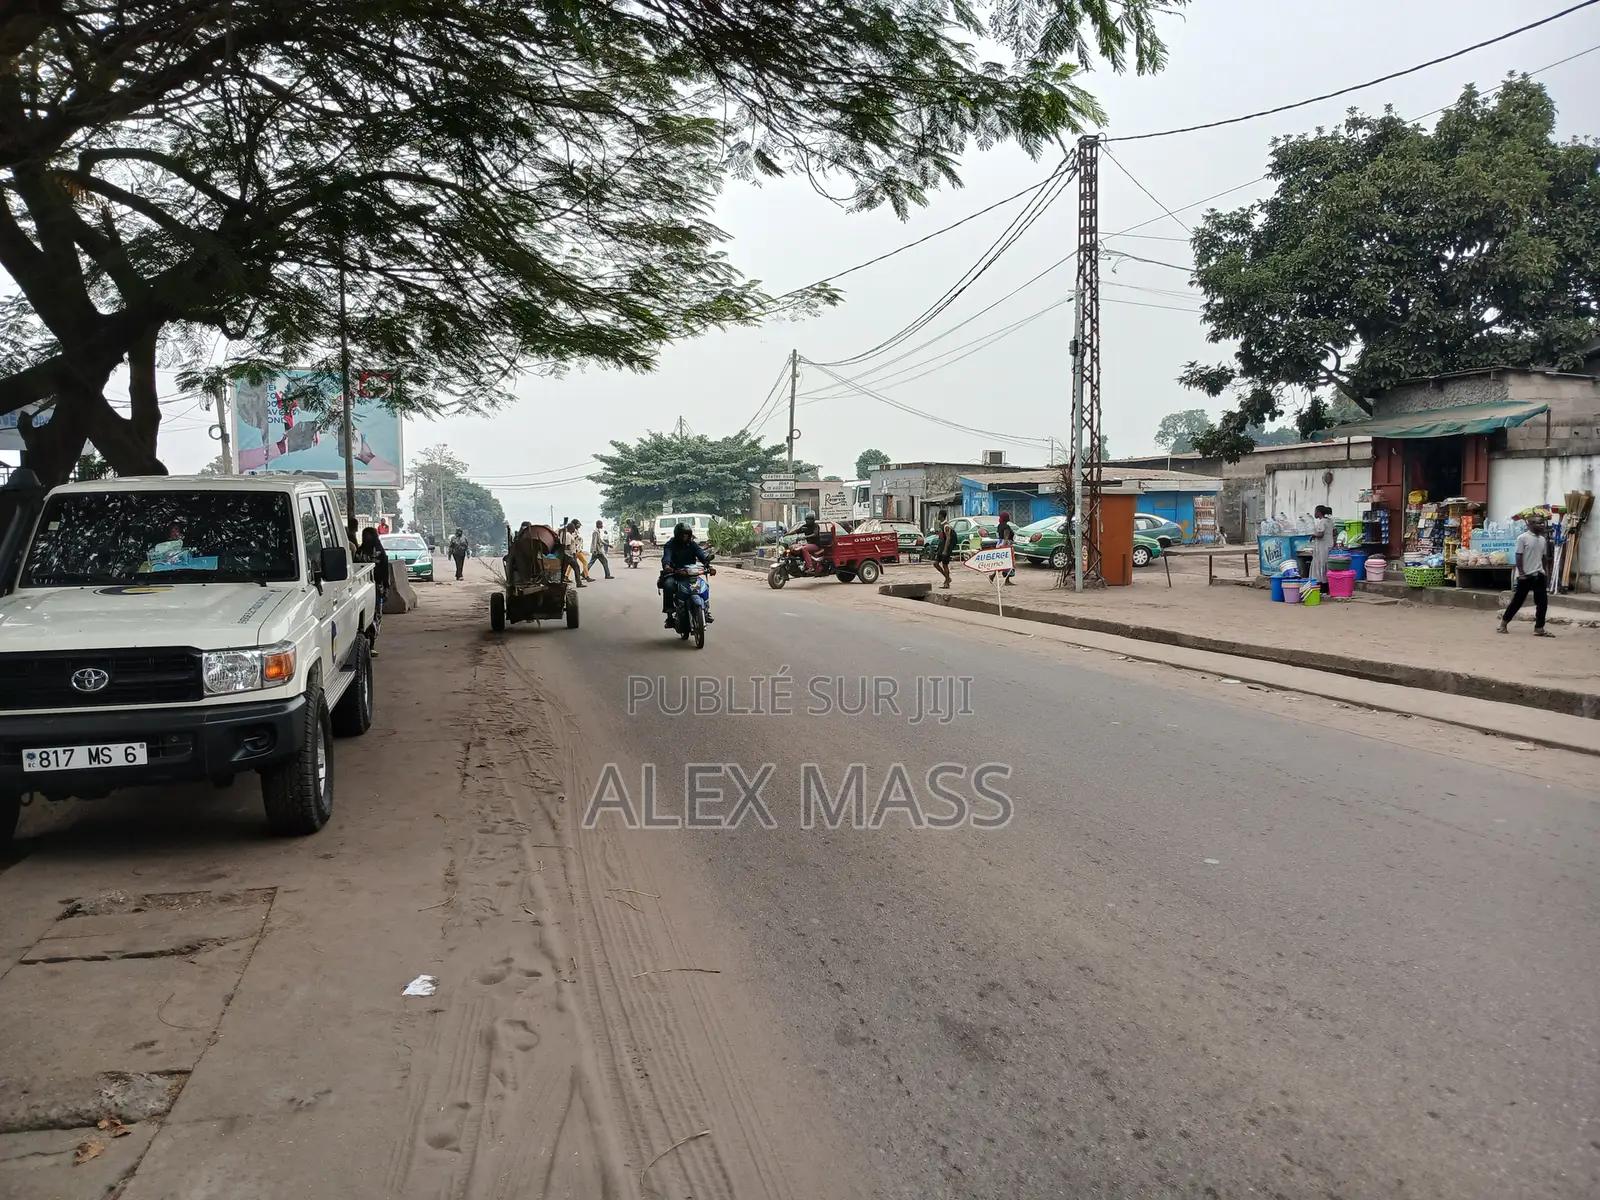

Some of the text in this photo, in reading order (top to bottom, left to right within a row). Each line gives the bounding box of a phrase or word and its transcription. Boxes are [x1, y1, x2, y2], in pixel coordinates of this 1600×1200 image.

[975, 551, 1009, 561] AUBERGE
[39, 749, 75, 768] 817
[88, 746, 112, 765] MS
[124, 746, 137, 763] 6
